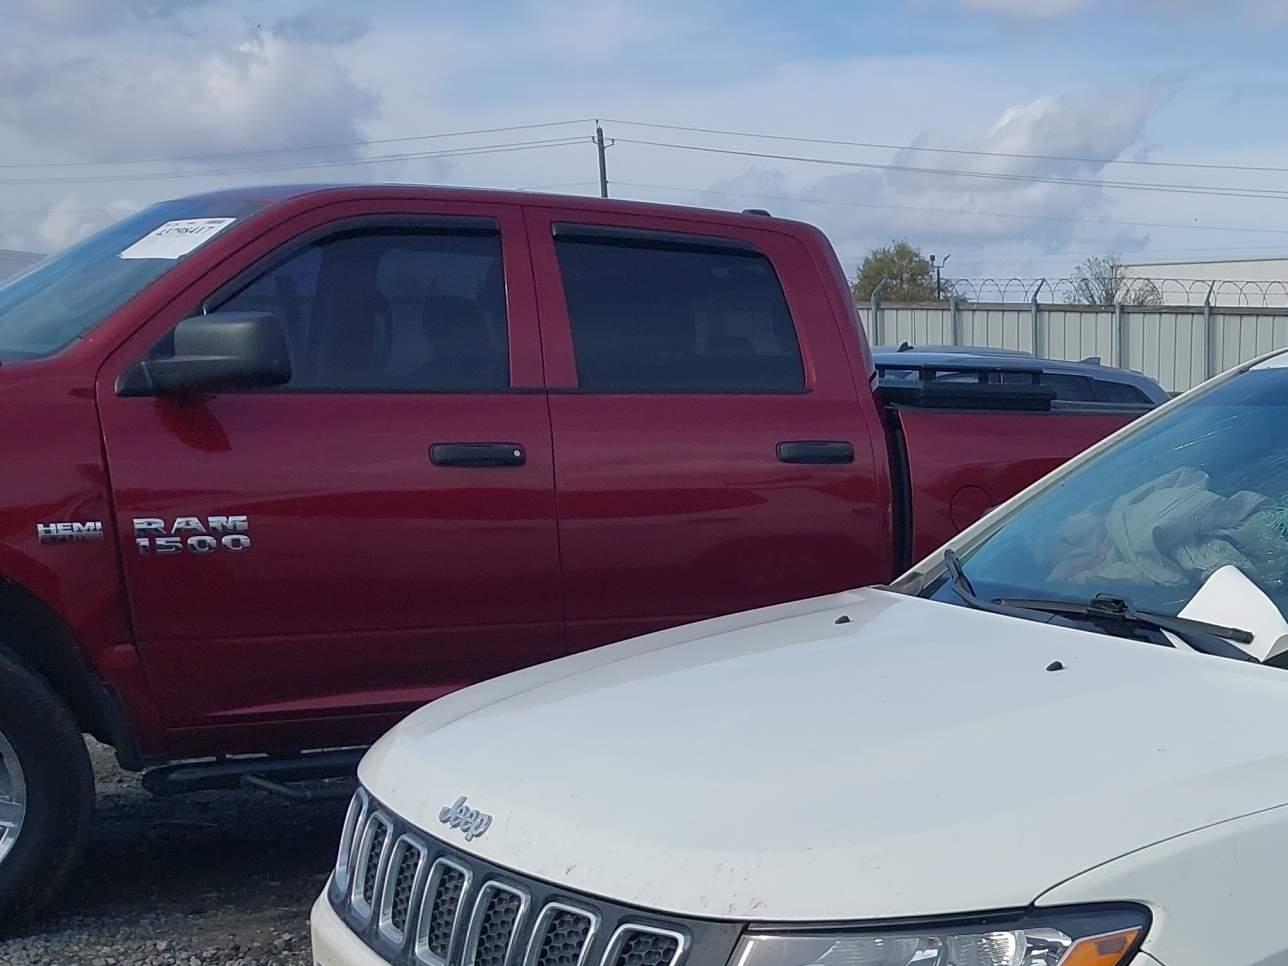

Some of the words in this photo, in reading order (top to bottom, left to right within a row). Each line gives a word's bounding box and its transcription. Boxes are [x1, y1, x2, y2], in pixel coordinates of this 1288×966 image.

[37, 521, 102, 536] HEMI
[133, 515, 249, 534] RAM
[136, 535, 250, 554] 1500
[439, 795, 492, 841] Jeep
